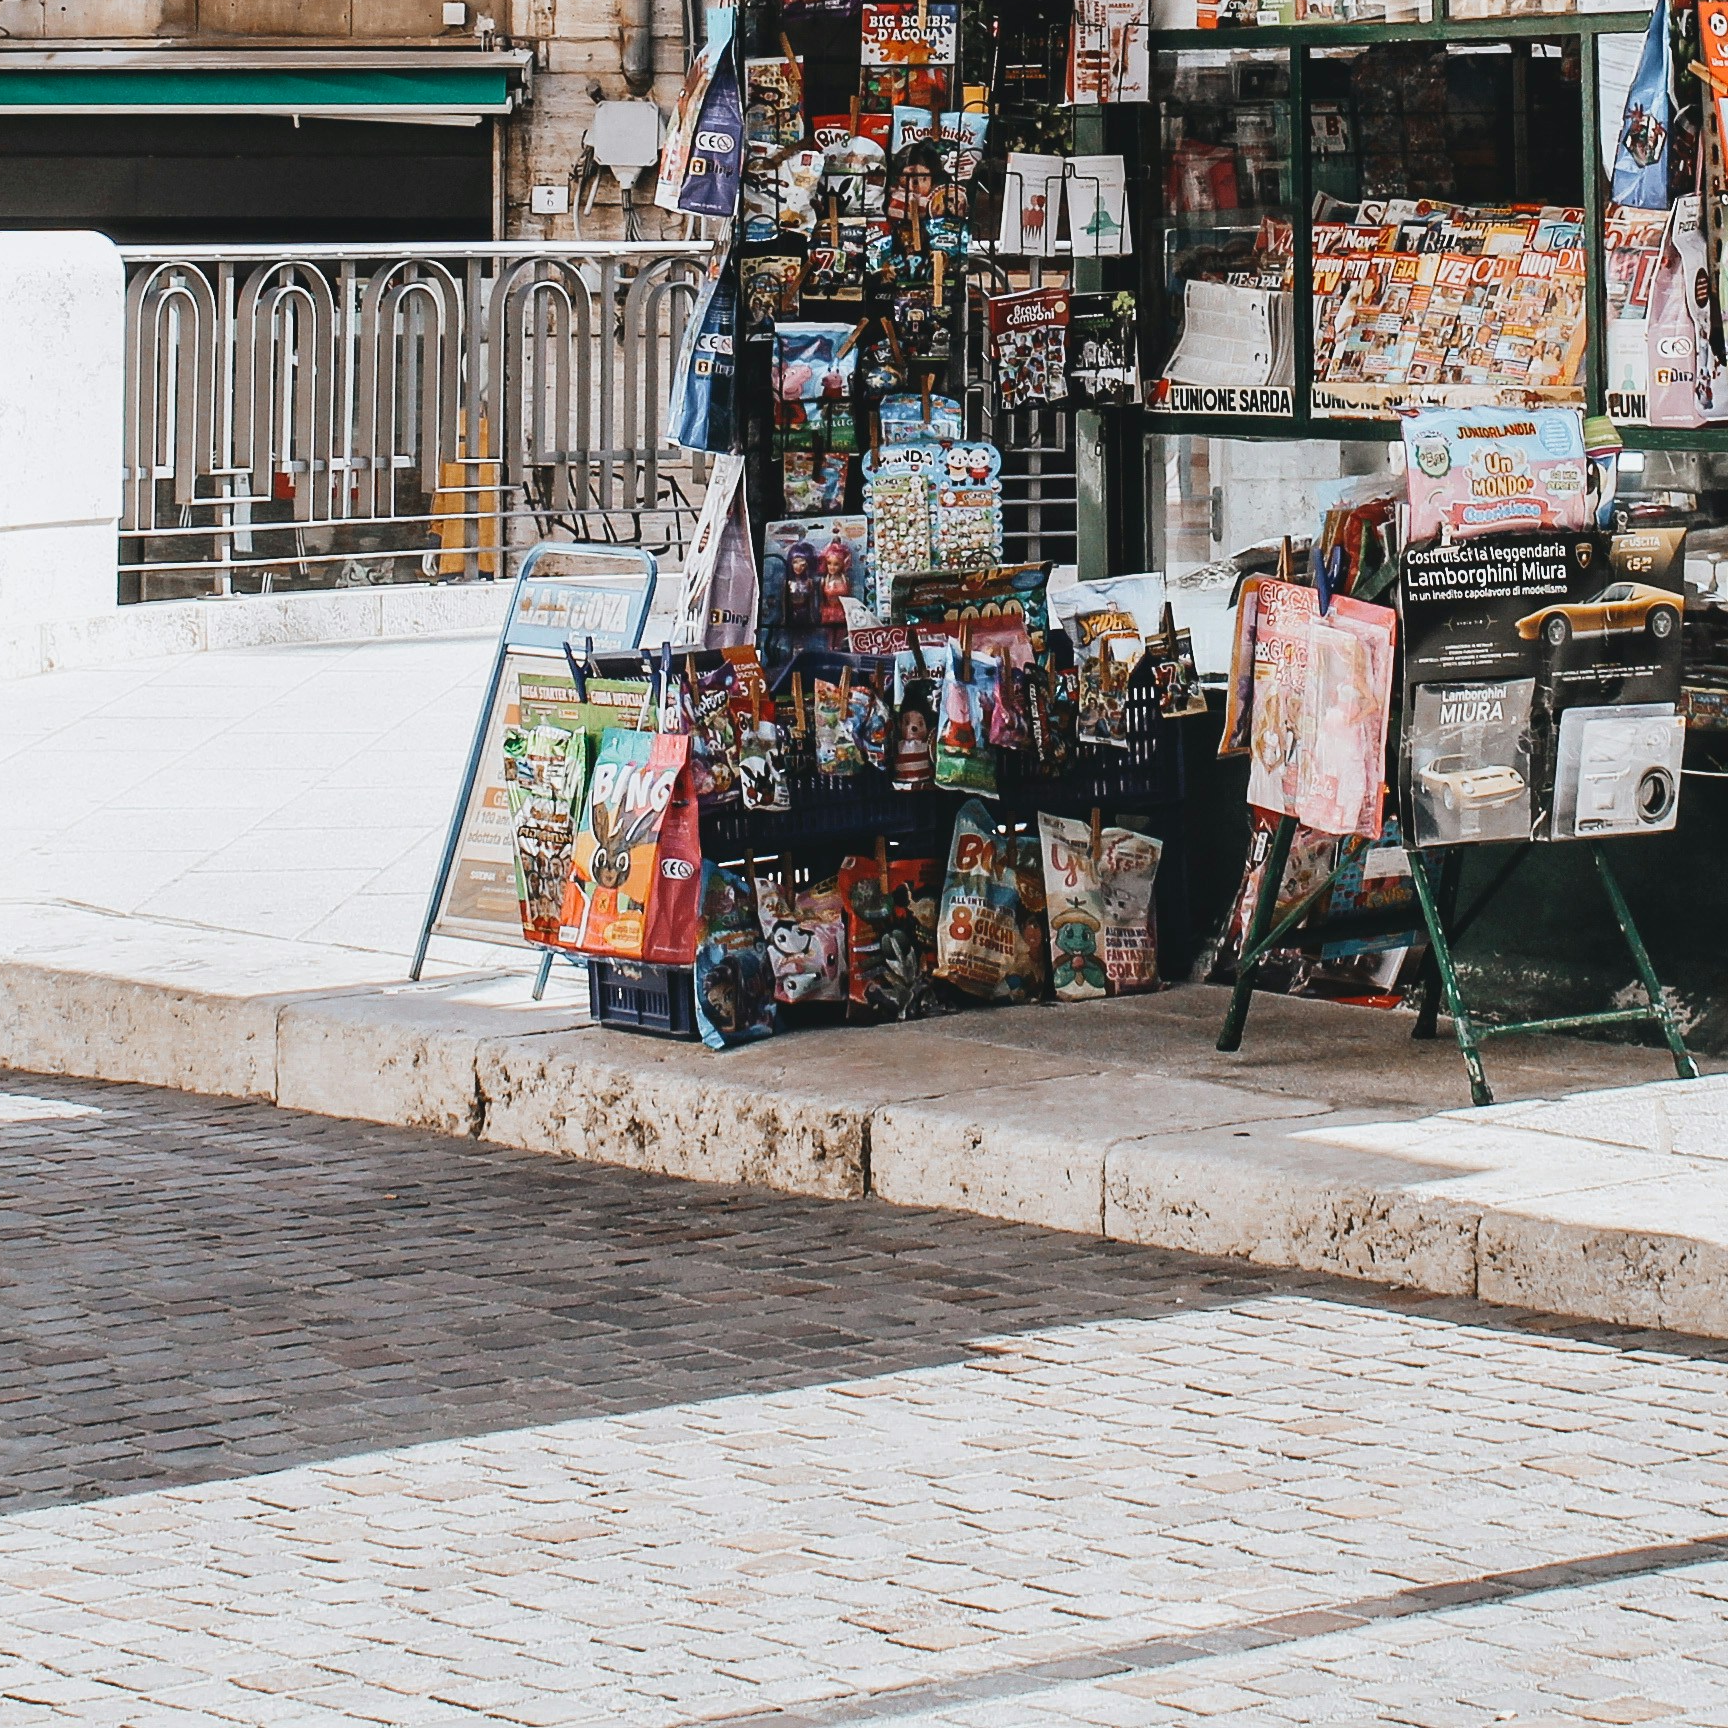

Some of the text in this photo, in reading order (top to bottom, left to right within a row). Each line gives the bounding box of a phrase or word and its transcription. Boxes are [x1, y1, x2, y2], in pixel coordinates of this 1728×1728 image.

[869, 14, 951, 27] BIG BOBE
[816, 129, 852, 148] Bing
[1006, 308, 1055, 326] Camboni
[1013, 302, 1041, 317] Bravi
[1171, 387, 1291, 414] L'UNIONE SARDA
[1456, 422, 1537, 440] JUNIORLANDIA
[1484, 452, 1514, 474] Un
[1473, 475, 1529, 498] MONDO
[1629, 535, 1661, 547] USCITA
[1490, 542, 1566, 565] leggendaria
[1406, 561, 1567, 588] Lamborghini Miura
[1464, 586, 1512, 600] capolavoro
[1521, 583, 1568, 595] modellismo
[1441, 685, 1508, 703] Lamborghini
[1439, 701, 1504, 725] MIURA
[949, 905, 973, 941] 8
